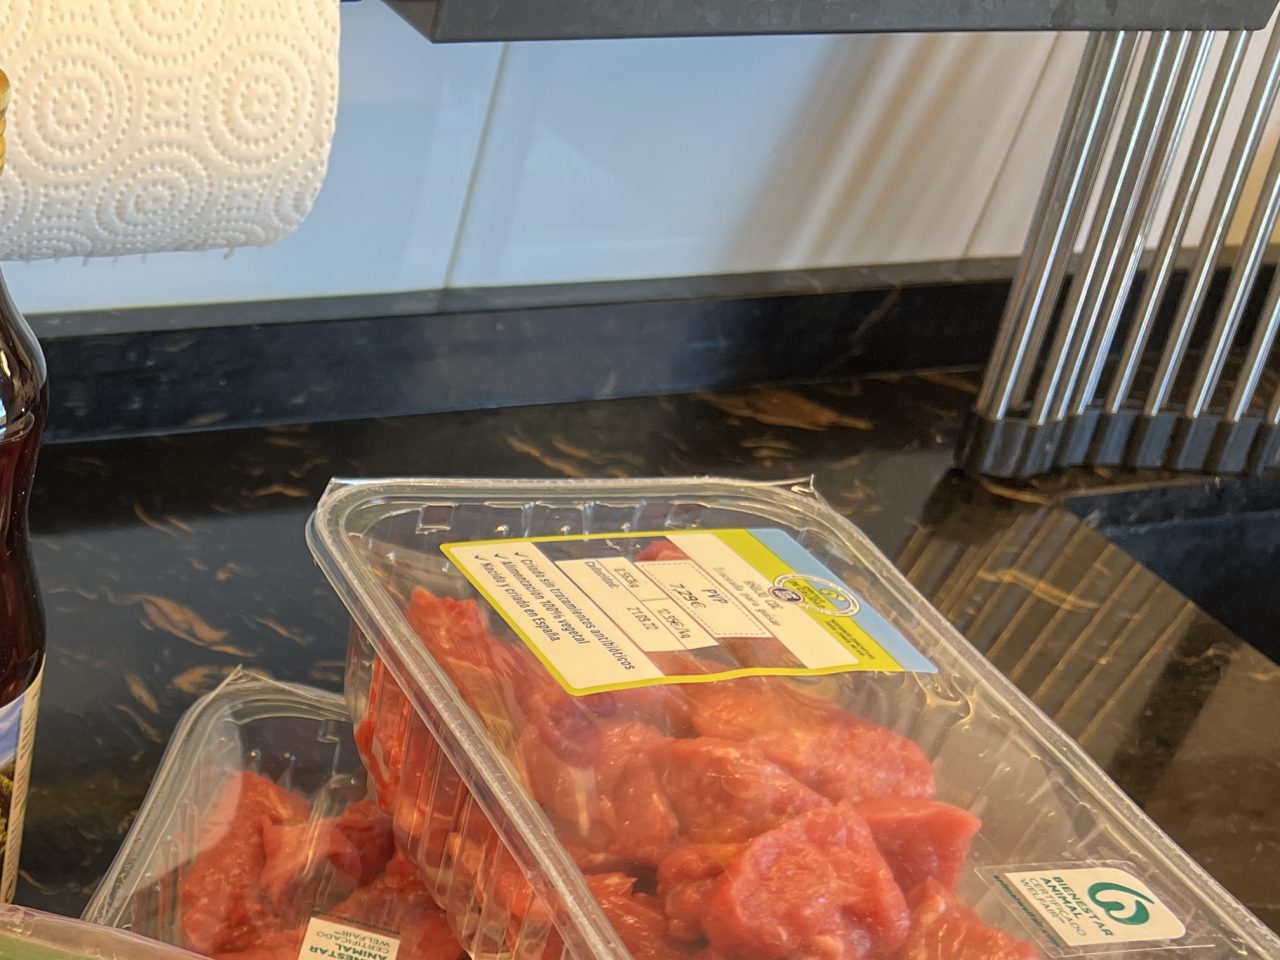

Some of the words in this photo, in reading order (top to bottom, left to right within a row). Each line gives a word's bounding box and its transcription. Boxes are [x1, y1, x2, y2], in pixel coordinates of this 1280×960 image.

[480, 562, 506, 583] Nacido
[504, 585, 530, 609] criado
[524, 606, 538, 618] en
[533, 613, 561, 642] España
[501, 561, 545, 600] Alimentación
[540, 599, 563, 620] 100%
[558, 618, 591, 645] vegetal
[521, 558, 545, 579] Criado
[540, 575, 555, 589] sin
[550, 586, 596, 631] tratamientos
[590, 627, 636, 670] antibióticos
[701, 589, 728, 604] PVP
[1028, 878, 1087, 936] CERTIFICADO
[1040, 877, 1084, 920] ANIMAL
[1053, 876, 1114, 936] BIENESTAR
[316, 931, 390, 954] CERTIFICADO
